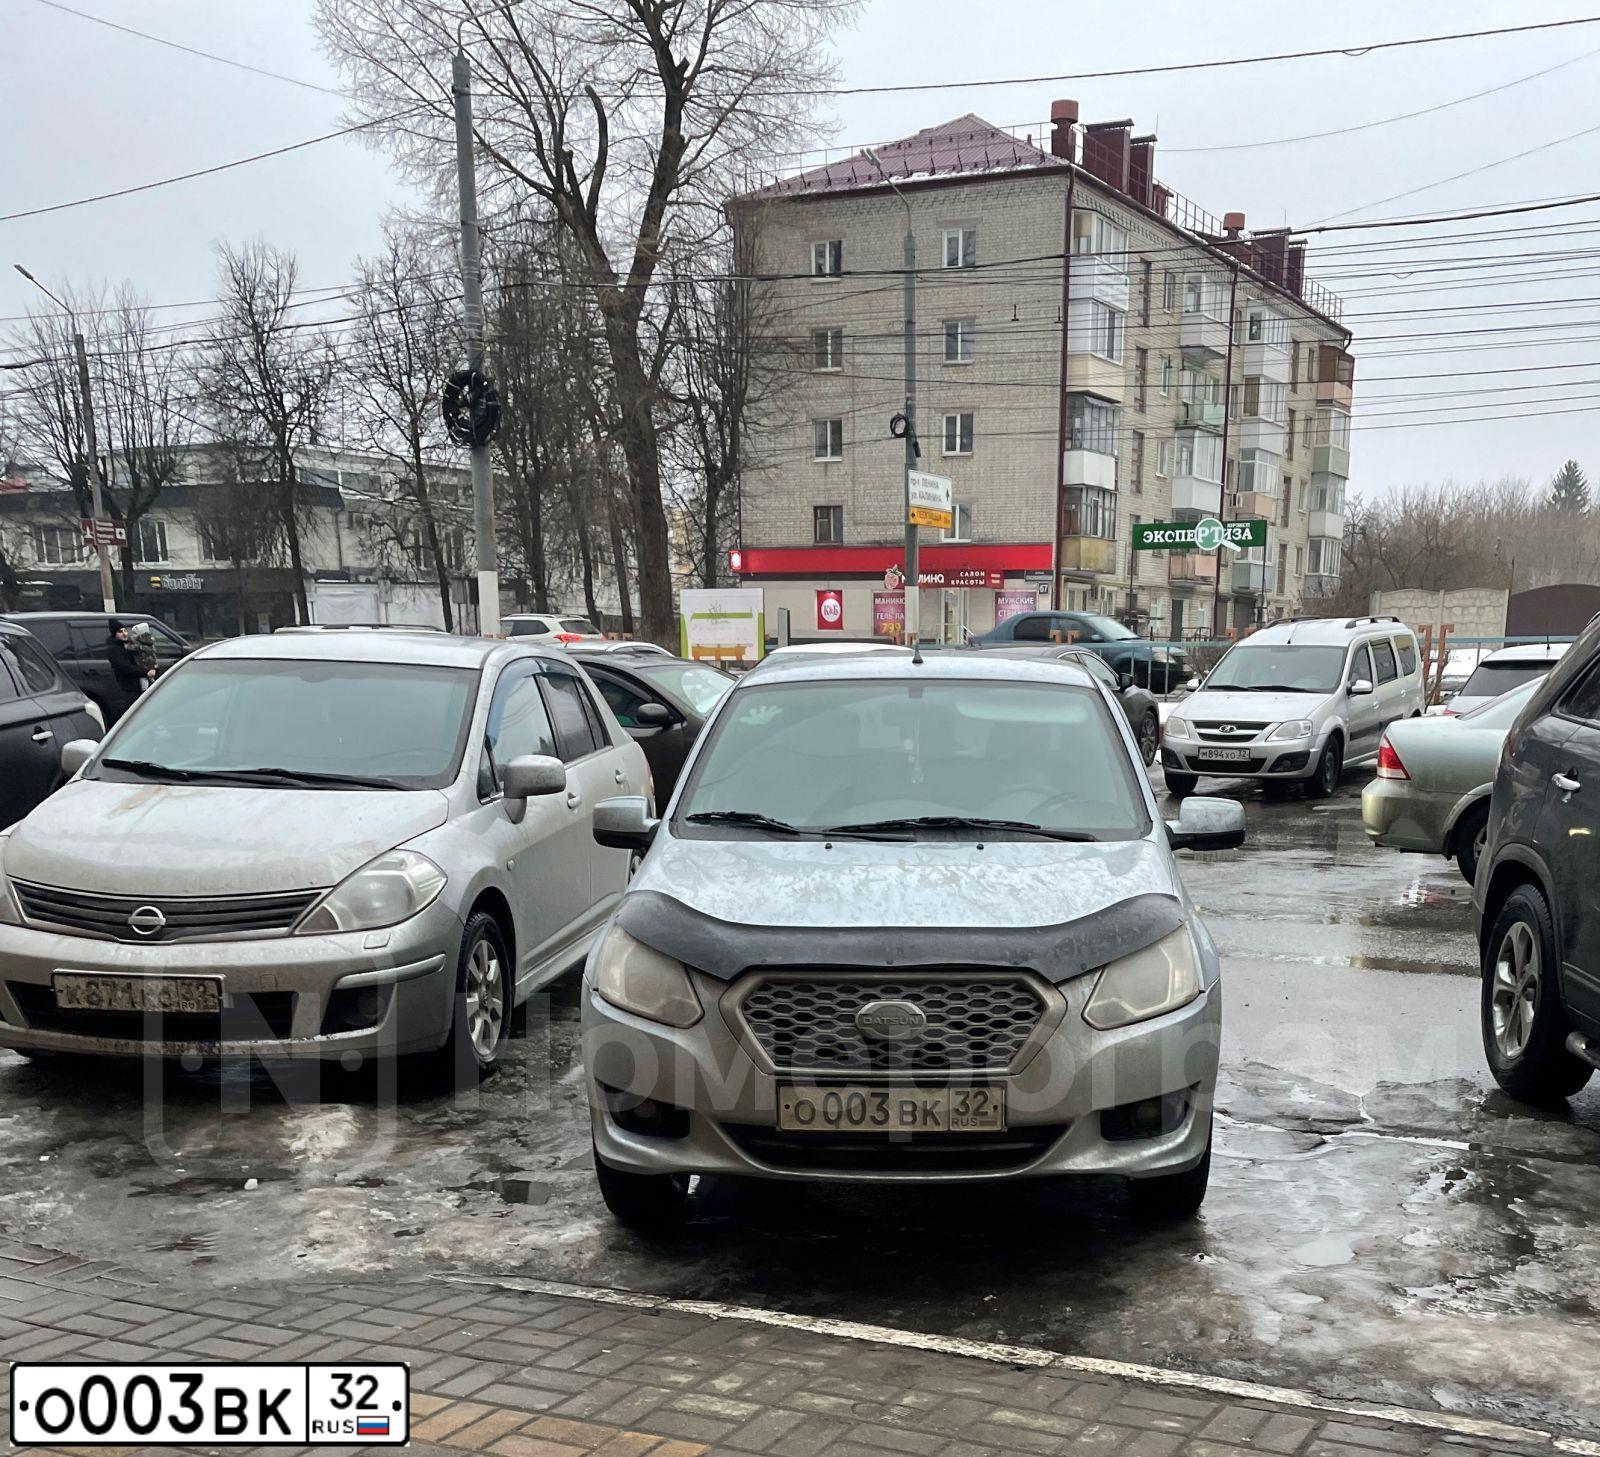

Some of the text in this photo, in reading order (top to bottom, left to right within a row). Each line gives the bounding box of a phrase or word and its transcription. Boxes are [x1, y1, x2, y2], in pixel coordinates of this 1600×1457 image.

[921, 478, 940, 489] ЛЕНИНА
[1142, 526, 1253, 544] ЭКСПЕРТИЗА
[997, 597, 1034, 605] МУЖСКИЕ
[881, 622, 902, 633] 799
[1201, 749, 1236, 760] М894ХО
[863, 1016, 920, 1025] DATSUN
[953, 1090, 989, 1117] 32
[951, 1117, 978, 1128] RUS
